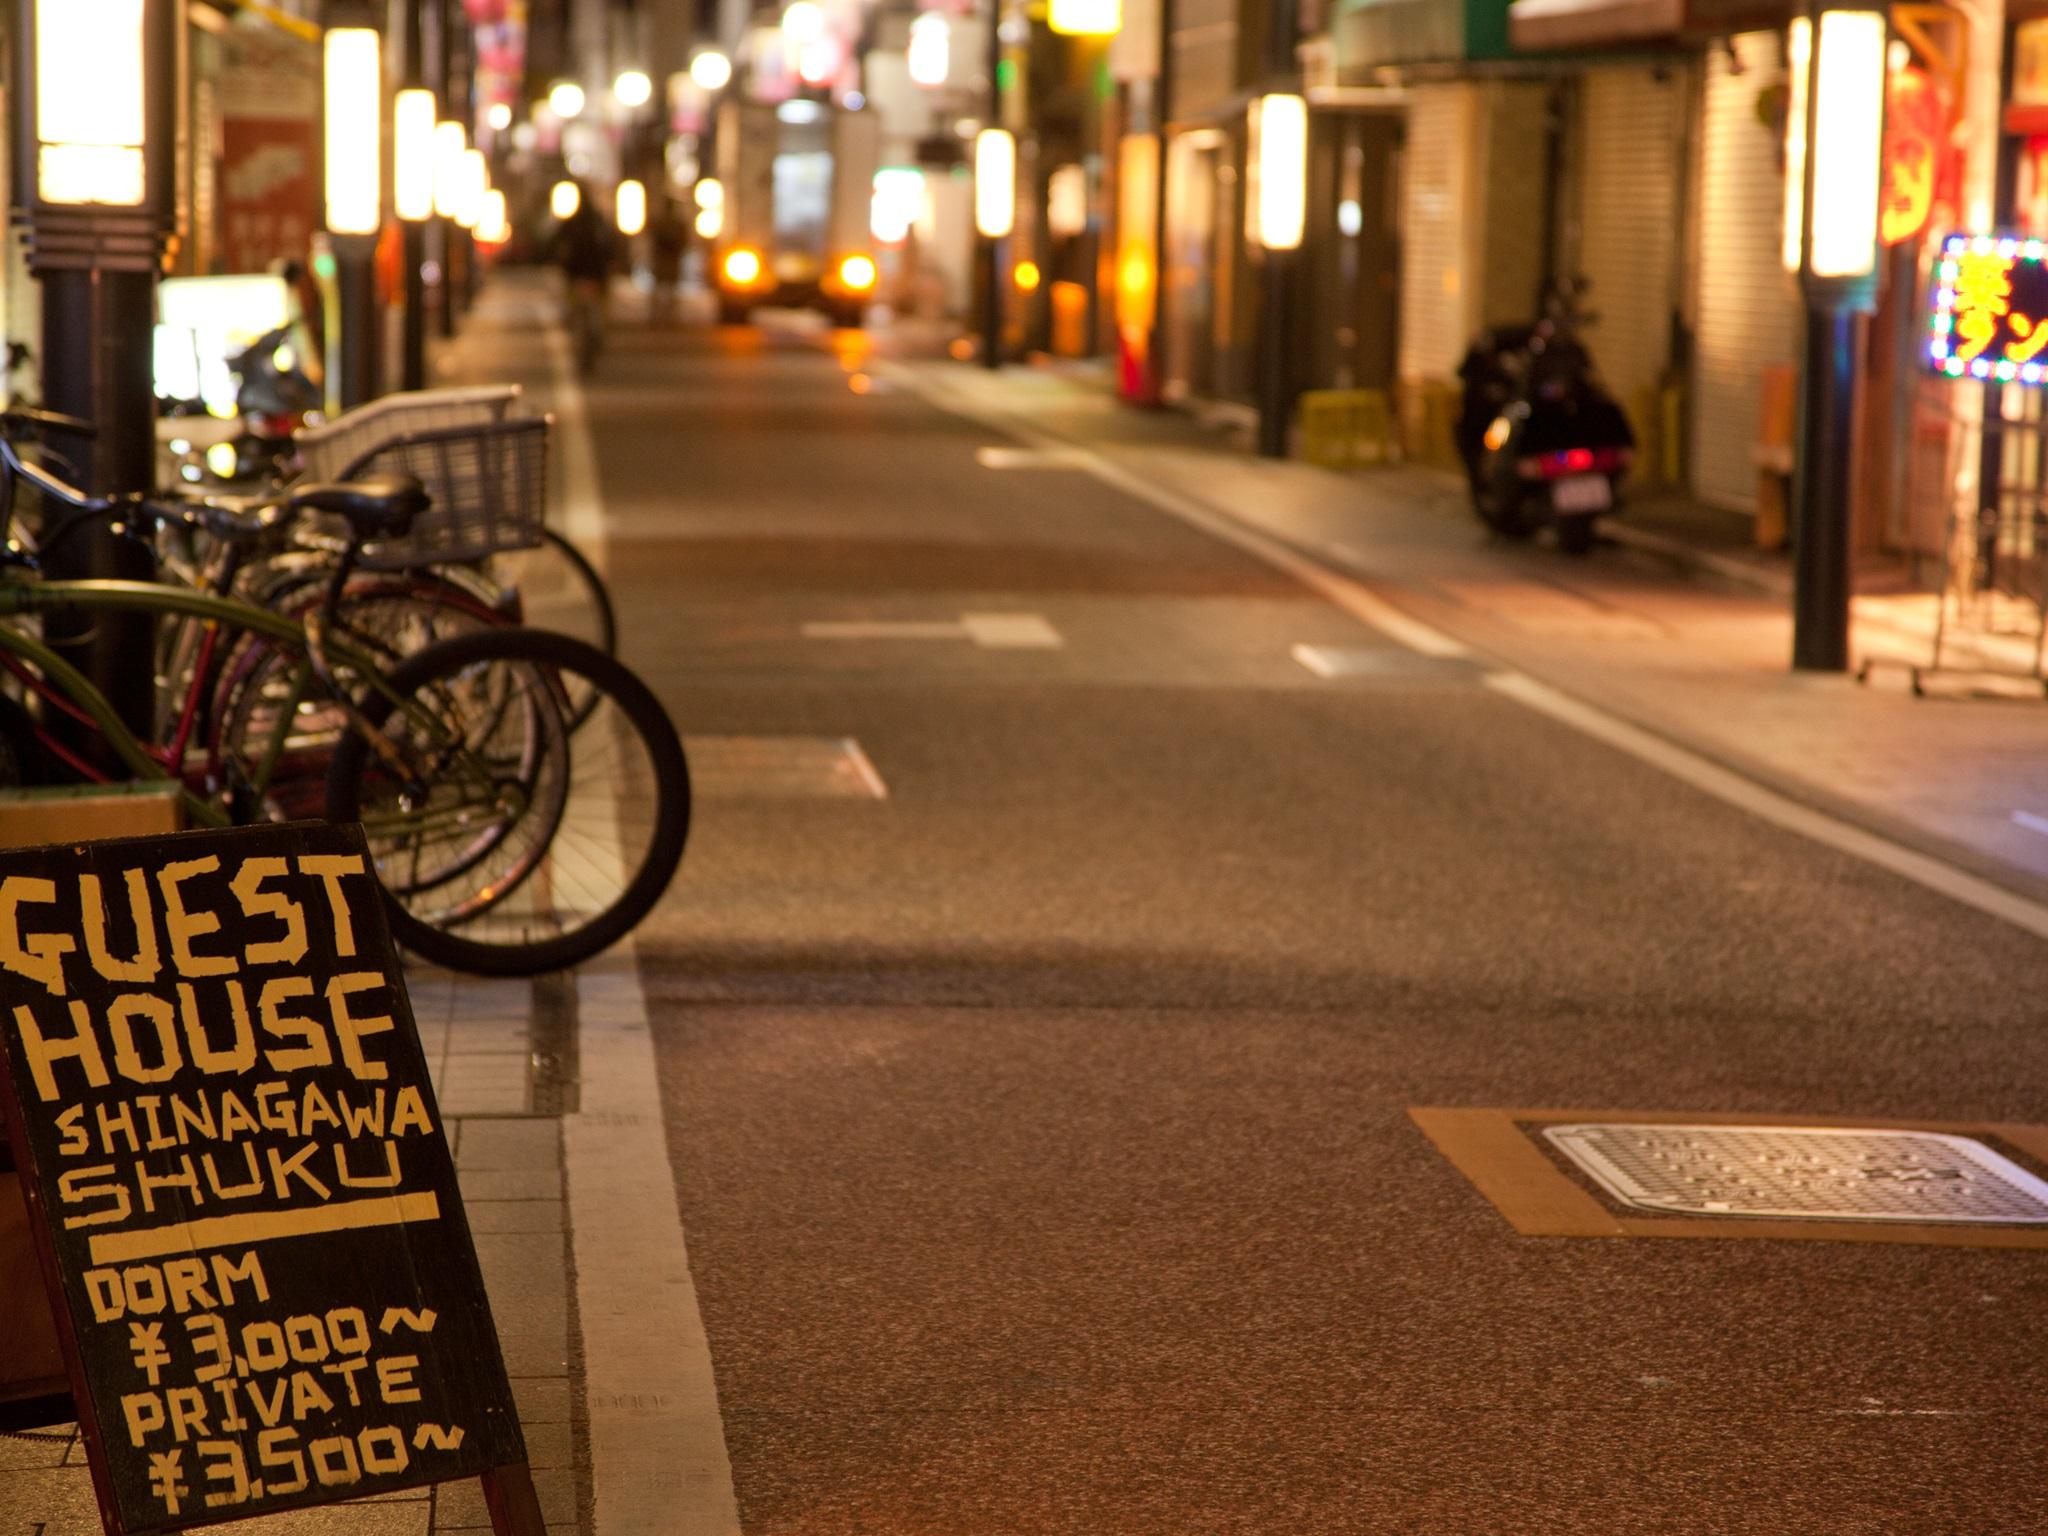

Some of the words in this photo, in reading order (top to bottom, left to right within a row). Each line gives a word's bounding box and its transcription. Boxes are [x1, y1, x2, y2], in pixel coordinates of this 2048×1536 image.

[0, 853, 365, 995] GUEST
[13, 972, 397, 1101] HOUSE
[55, 1083, 433, 1155] SHINAGAWA
[58, 1141, 402, 1229] SHUKU
[83, 1250, 270, 1322] DORM
[121, 1354, 422, 1447] PRIVATE
